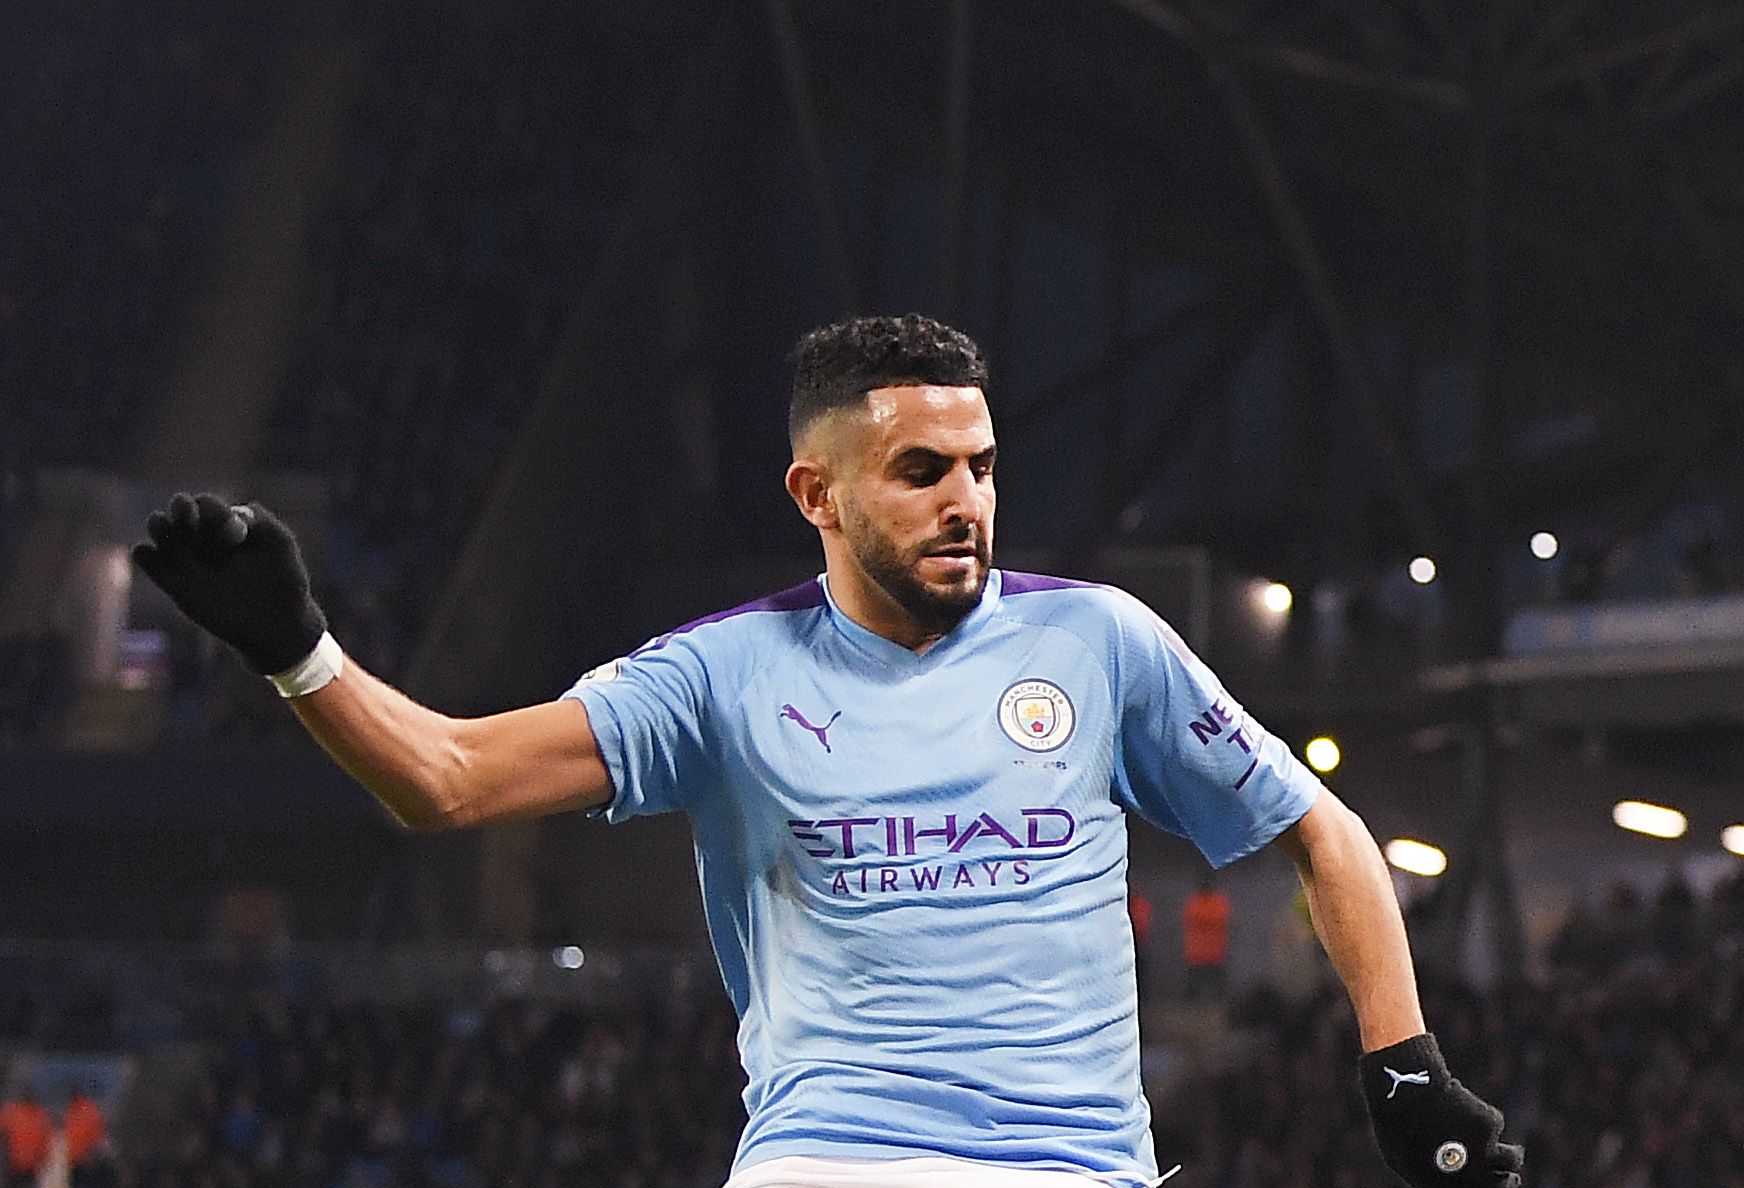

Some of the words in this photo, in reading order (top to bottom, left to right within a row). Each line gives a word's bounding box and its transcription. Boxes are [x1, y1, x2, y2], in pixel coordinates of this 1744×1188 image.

[1005, 685, 1064, 707] MANCHESTER
[788, 808, 1075, 859] ETIHAD
[832, 860, 1030, 895] AIRWAYS
